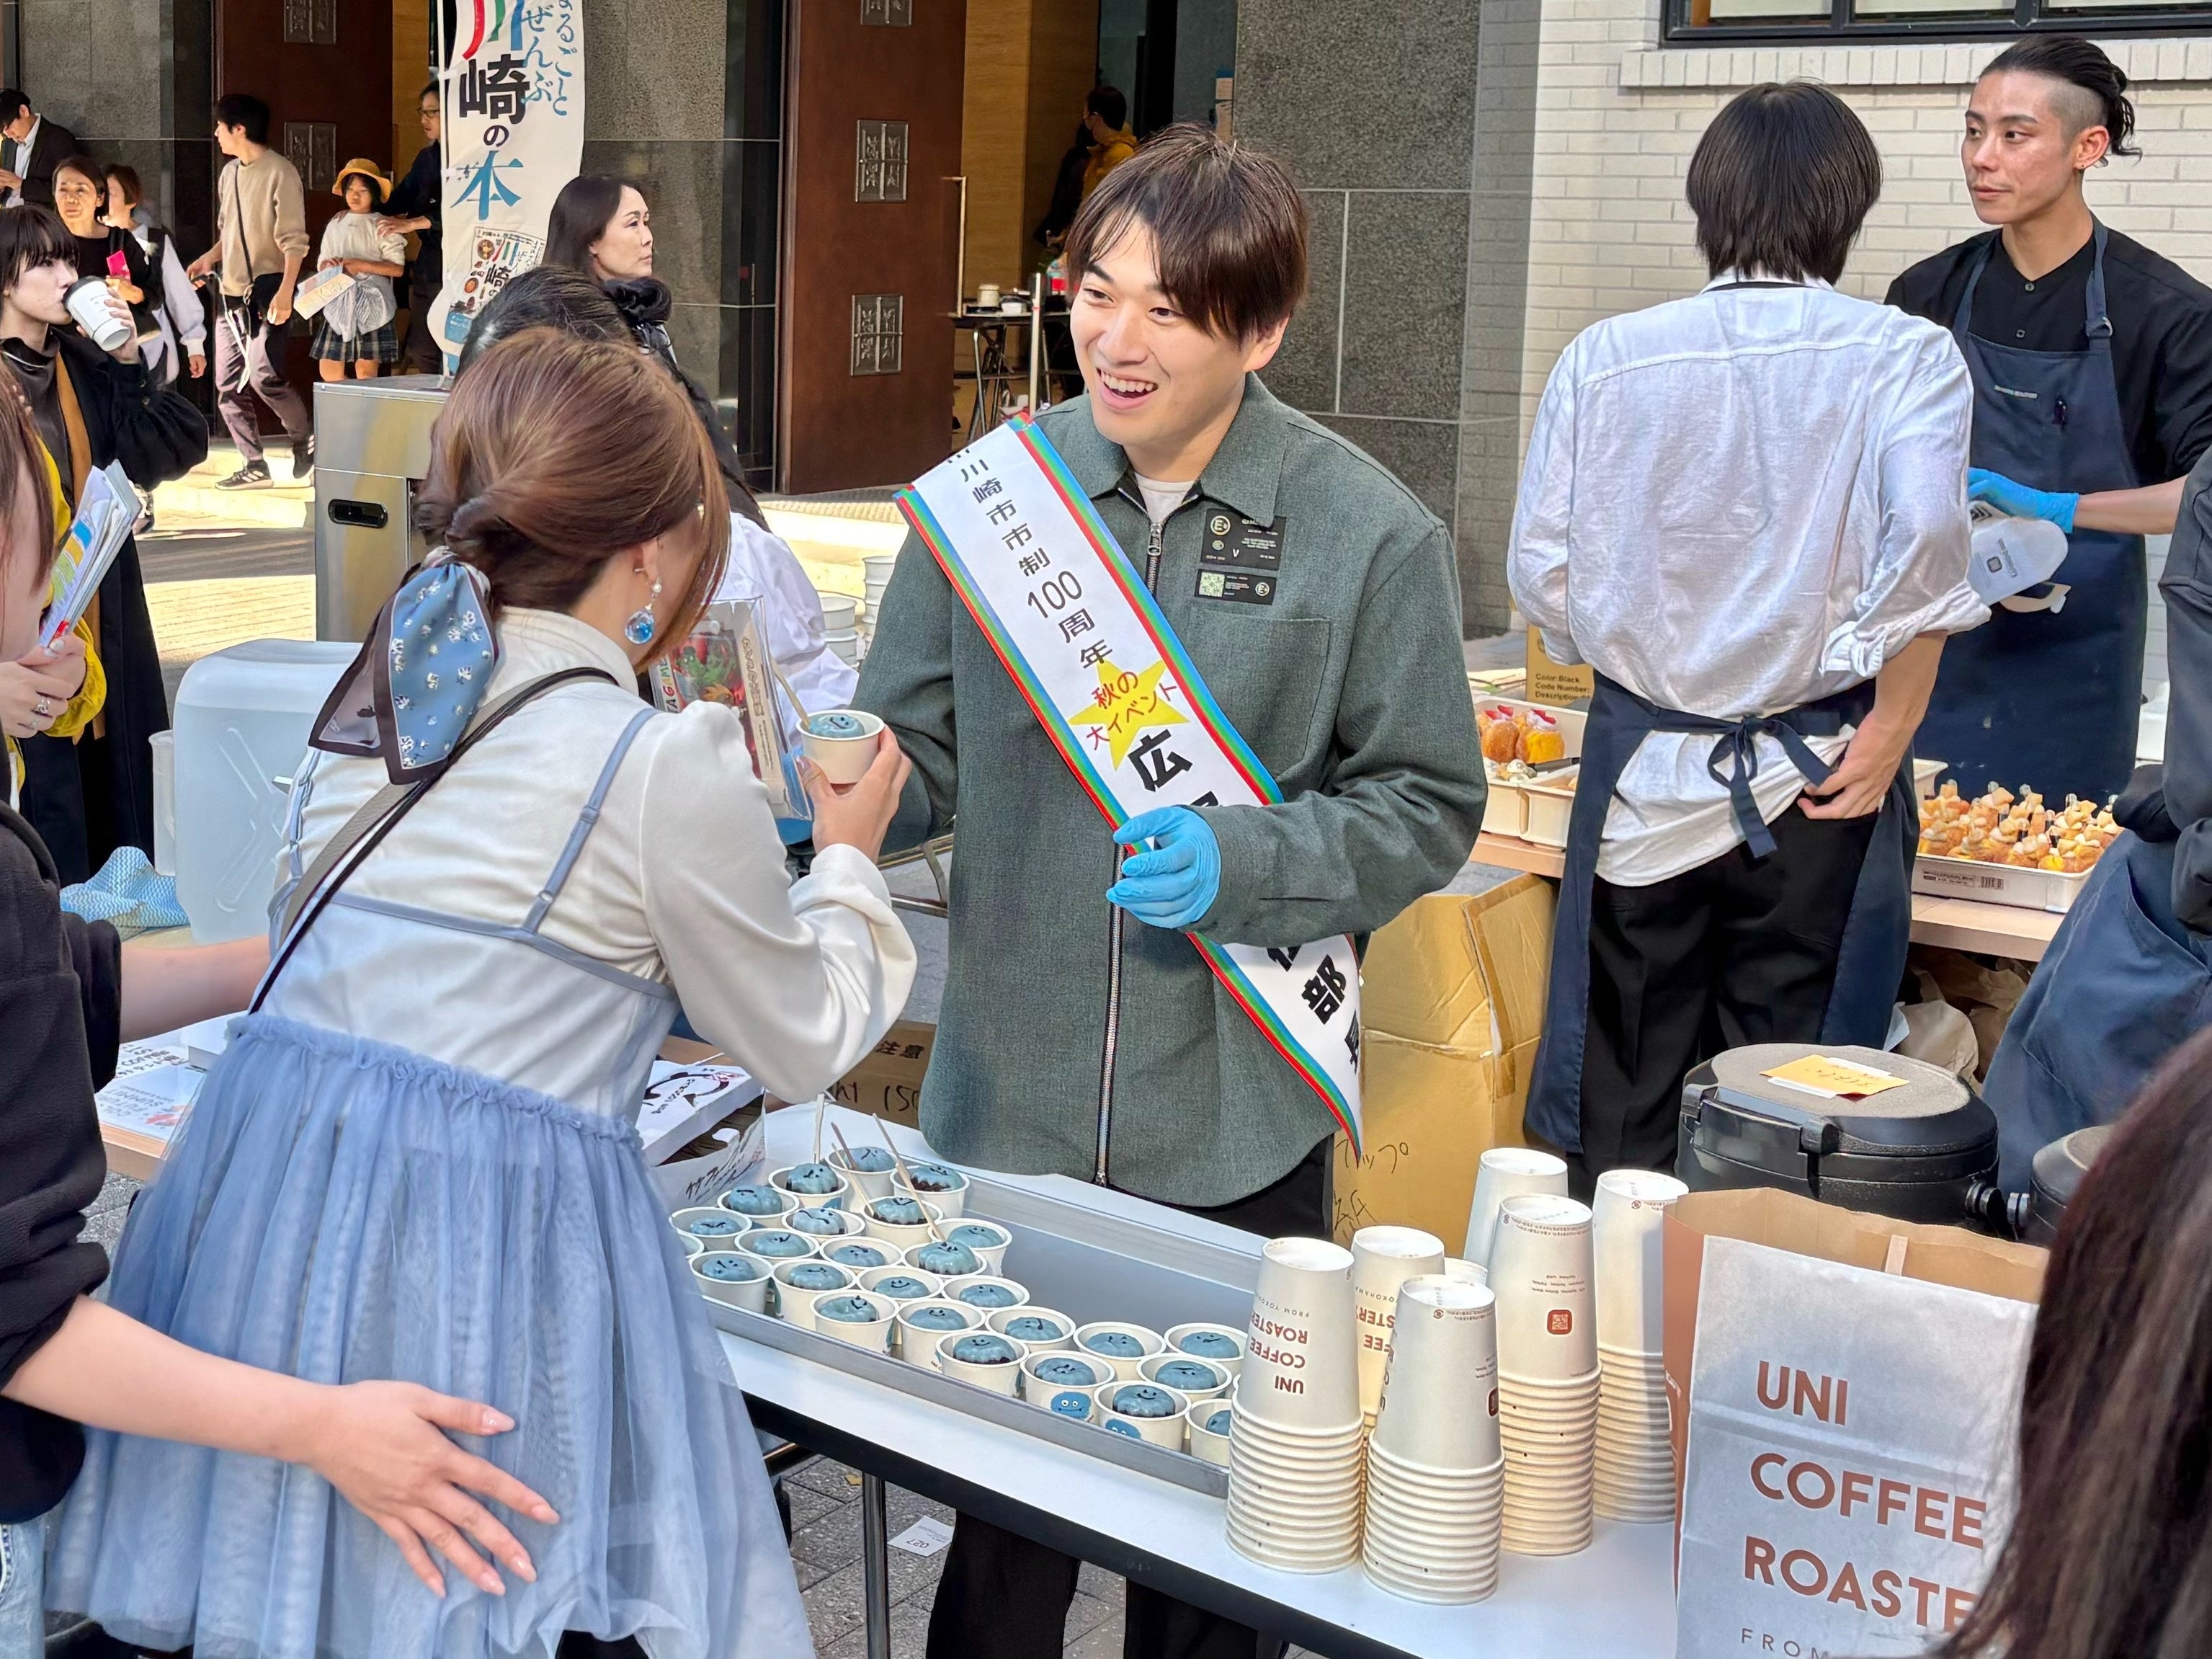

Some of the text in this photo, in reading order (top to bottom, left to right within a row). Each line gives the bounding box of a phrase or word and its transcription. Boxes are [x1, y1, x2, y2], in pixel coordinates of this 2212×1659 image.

[522, 4, 553, 102] ぜんぶ
[960, 458, 1112, 669] 川崎市市制100周年
[1087, 683, 1177, 750] 大イベント
[1092, 672, 1138, 709] 秋の
[1249, 1336, 1306, 1369] COFFEE
[1275, 1374, 1304, 1394] UNI
[1757, 1360, 1848, 1426] UNI
[1750, 1452, 1987, 1549] COFFEE
